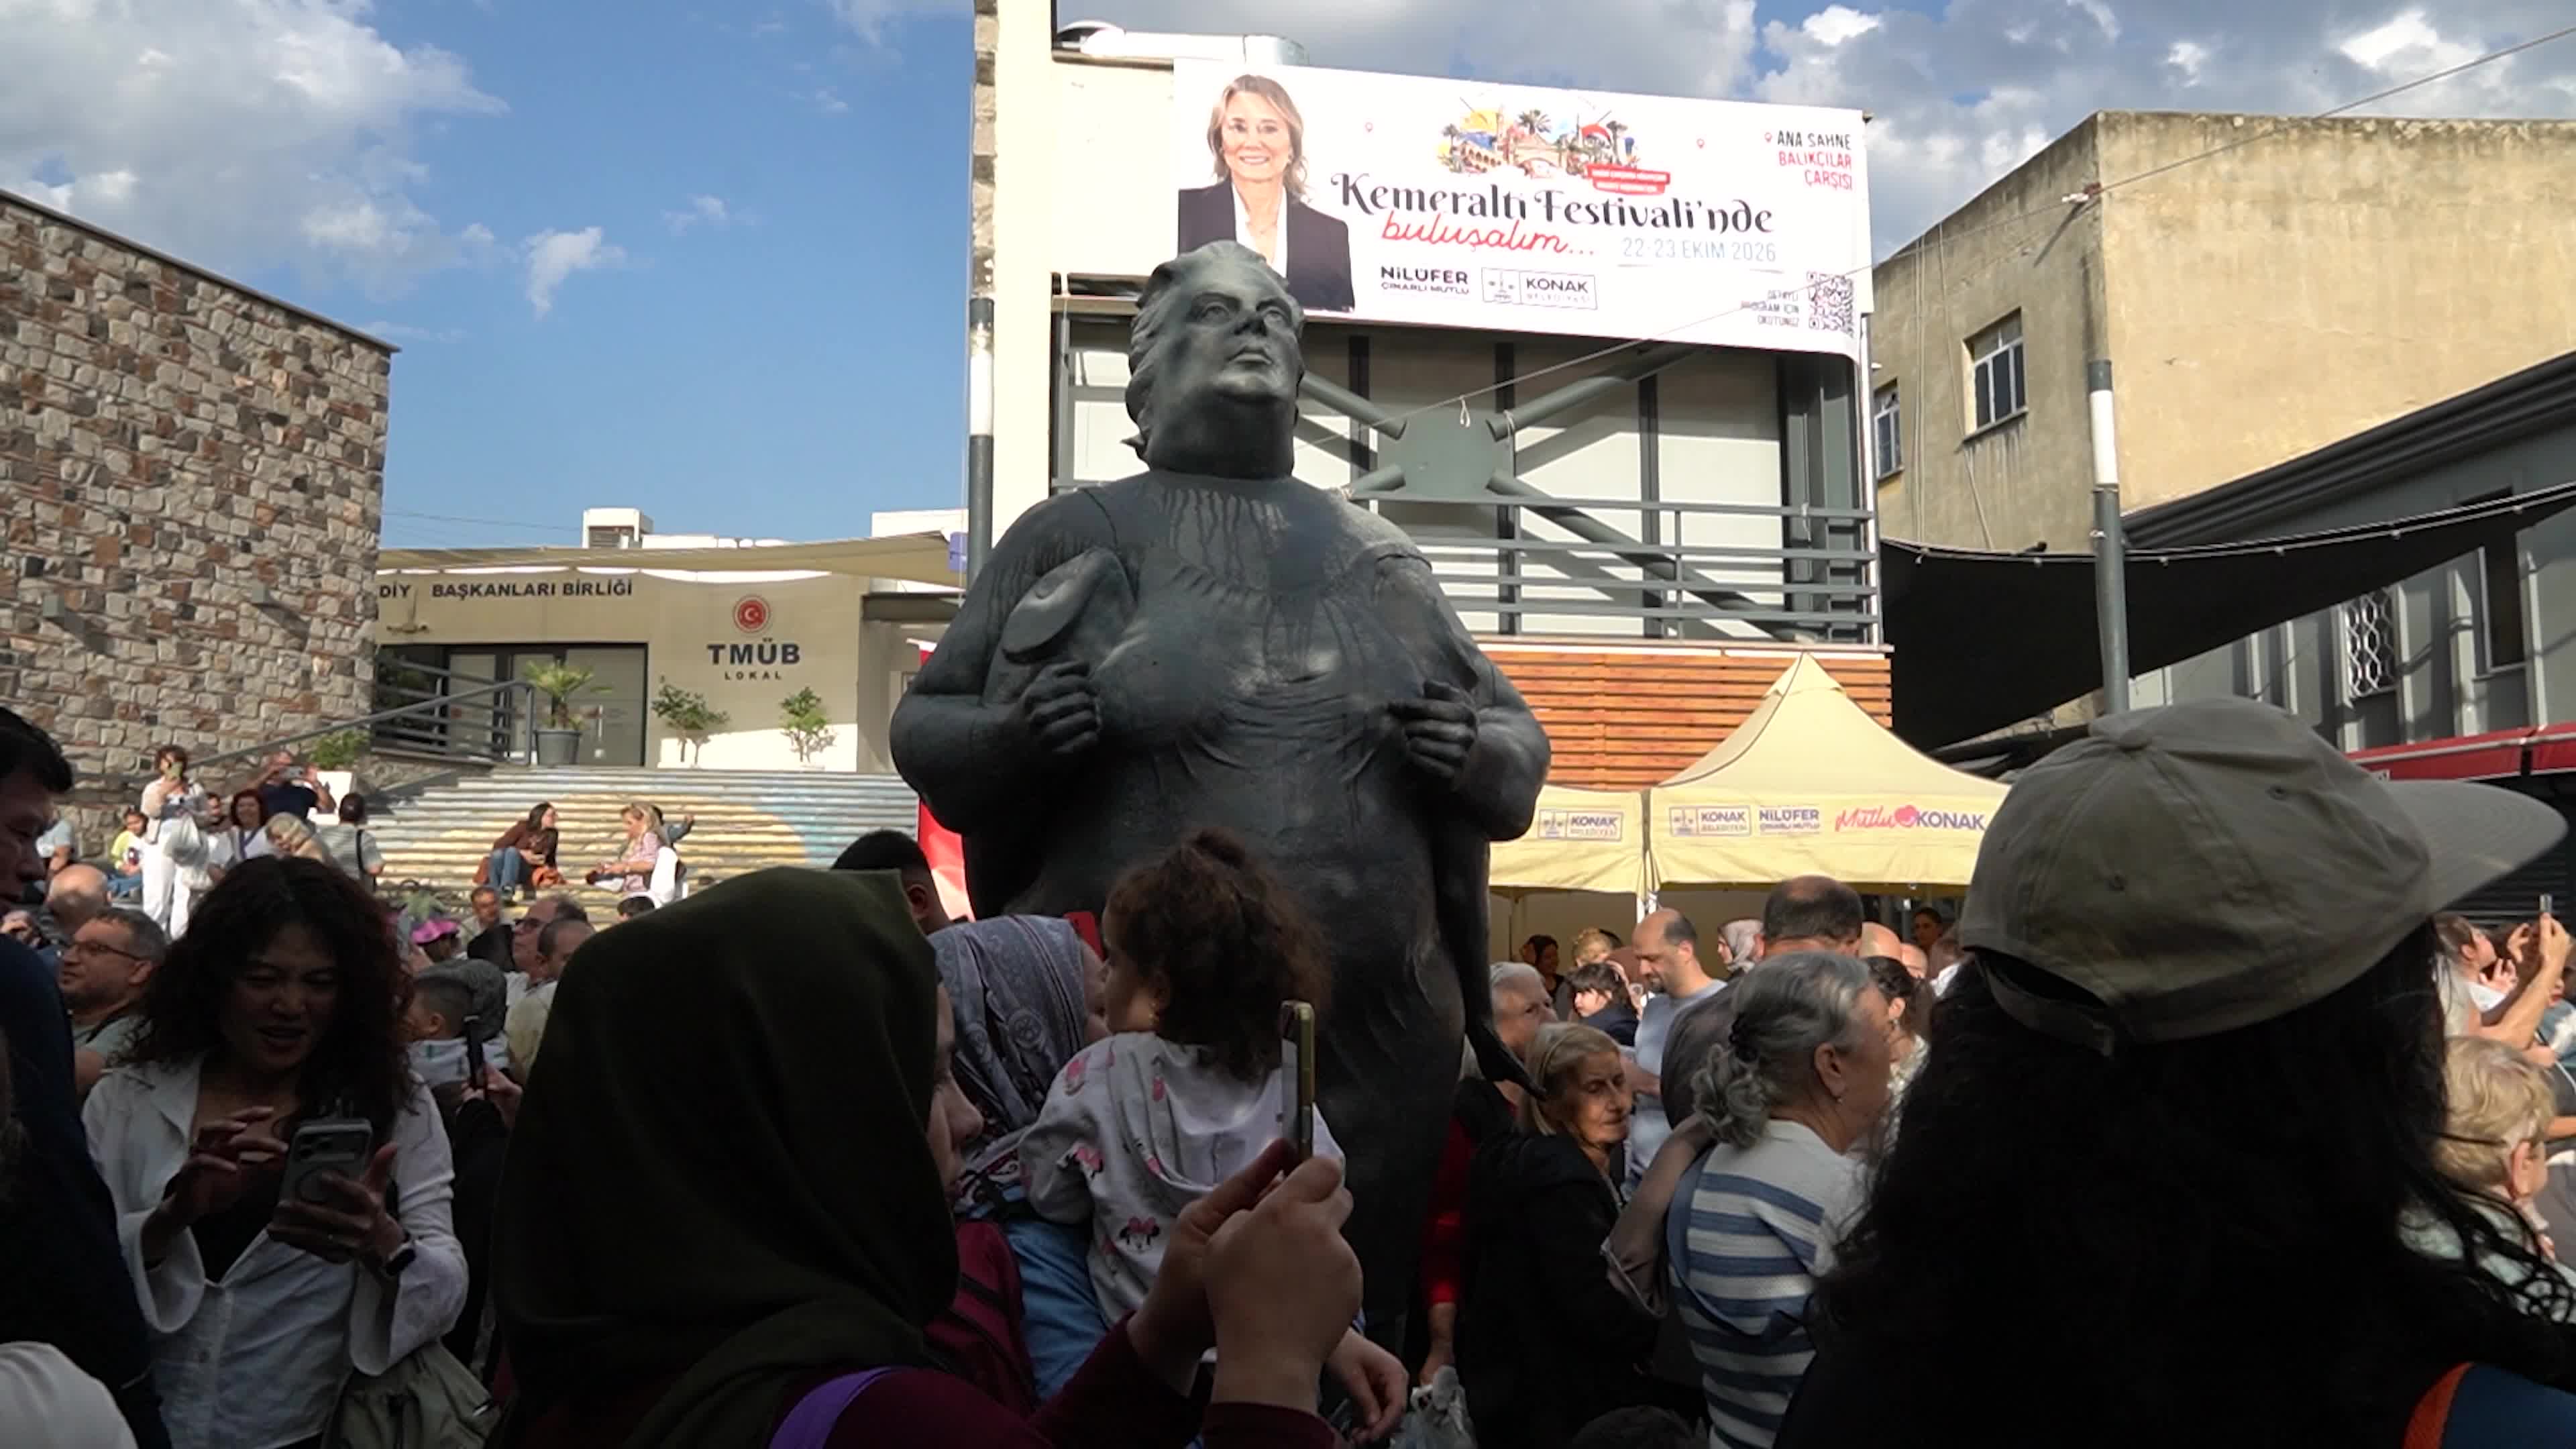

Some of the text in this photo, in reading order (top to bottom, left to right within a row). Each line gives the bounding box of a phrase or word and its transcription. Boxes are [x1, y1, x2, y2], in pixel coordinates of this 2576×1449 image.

[1778, 130, 1851, 150] ANA SAHNE
[1805, 169, 1852, 190] ÇARŞISI
[1331, 173, 1774, 234] Kemeraltı Festivali'nde
[1732, 241, 1776, 262] 2026
[1526, 278, 1589, 293] KONAK
[432, 583, 555, 600] BAŞKANLARI
[563, 579, 633, 596] BİRLİĞİ
[706, 637, 800, 665] TMÜB
[724, 671, 782, 680] LOKAL
[1571, 815, 1618, 826] KONAK
[1701, 811, 1746, 822] KONAK
[1916, 810, 1986, 830] KONAK
